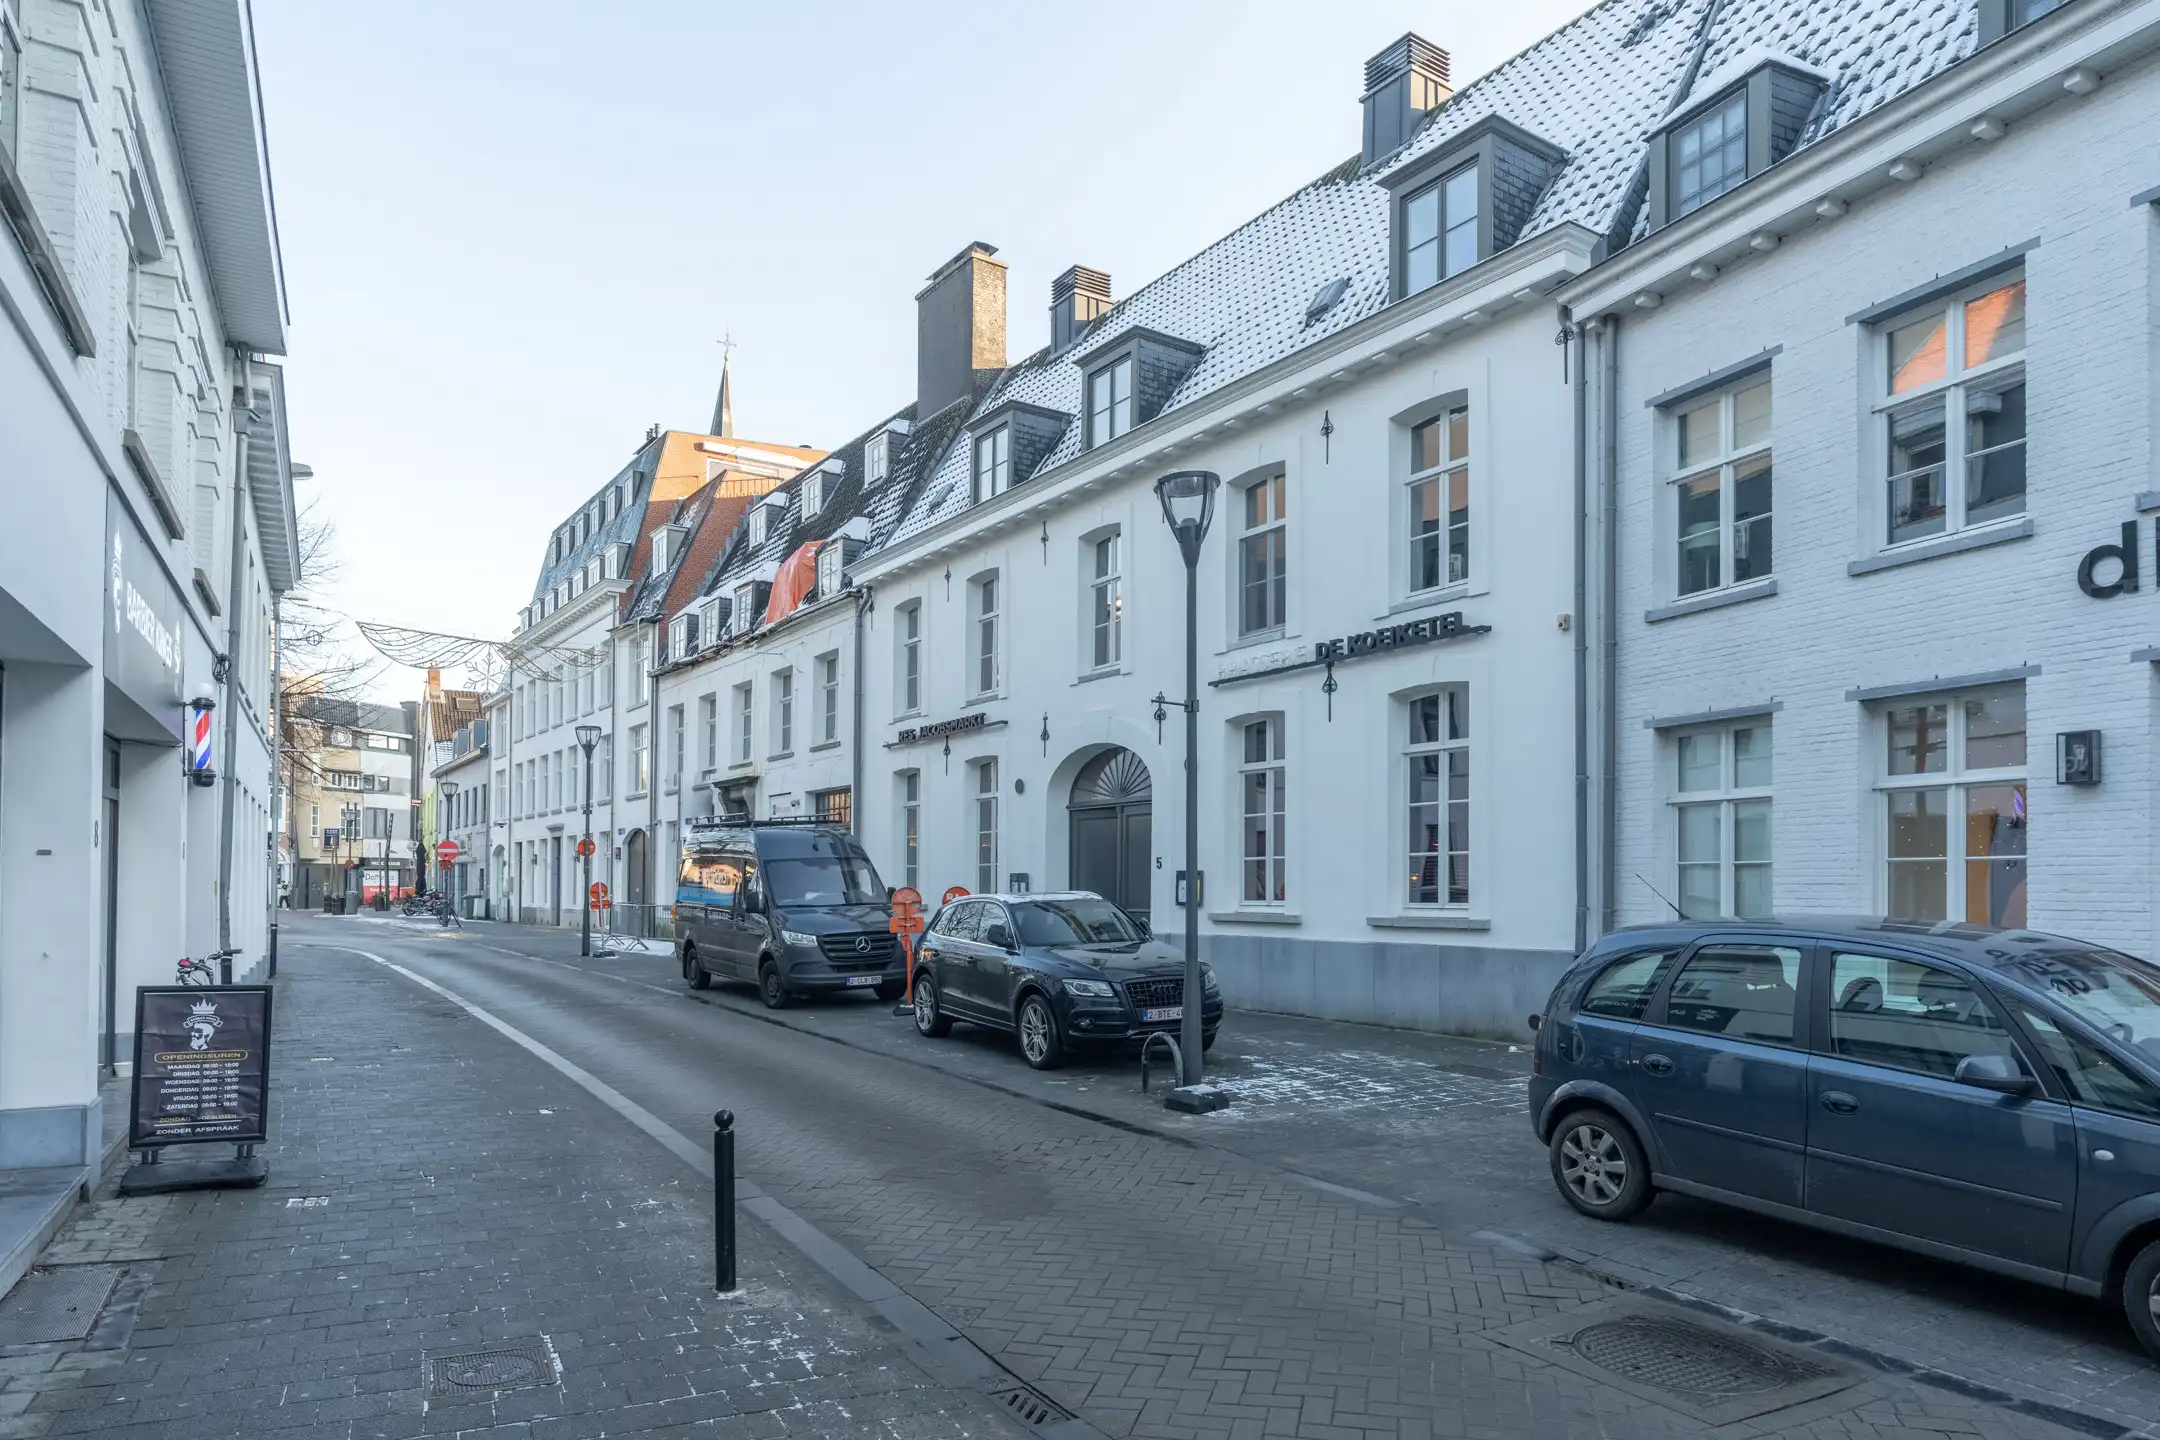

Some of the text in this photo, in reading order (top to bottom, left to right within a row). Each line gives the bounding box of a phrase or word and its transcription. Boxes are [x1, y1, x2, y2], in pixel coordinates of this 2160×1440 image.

[1315, 638, 1345, 662] DE
[919, 712, 986, 739] JACOBSMARKT
[94, 820, 99, 849] 8
[1156, 856, 1163, 870] 5
